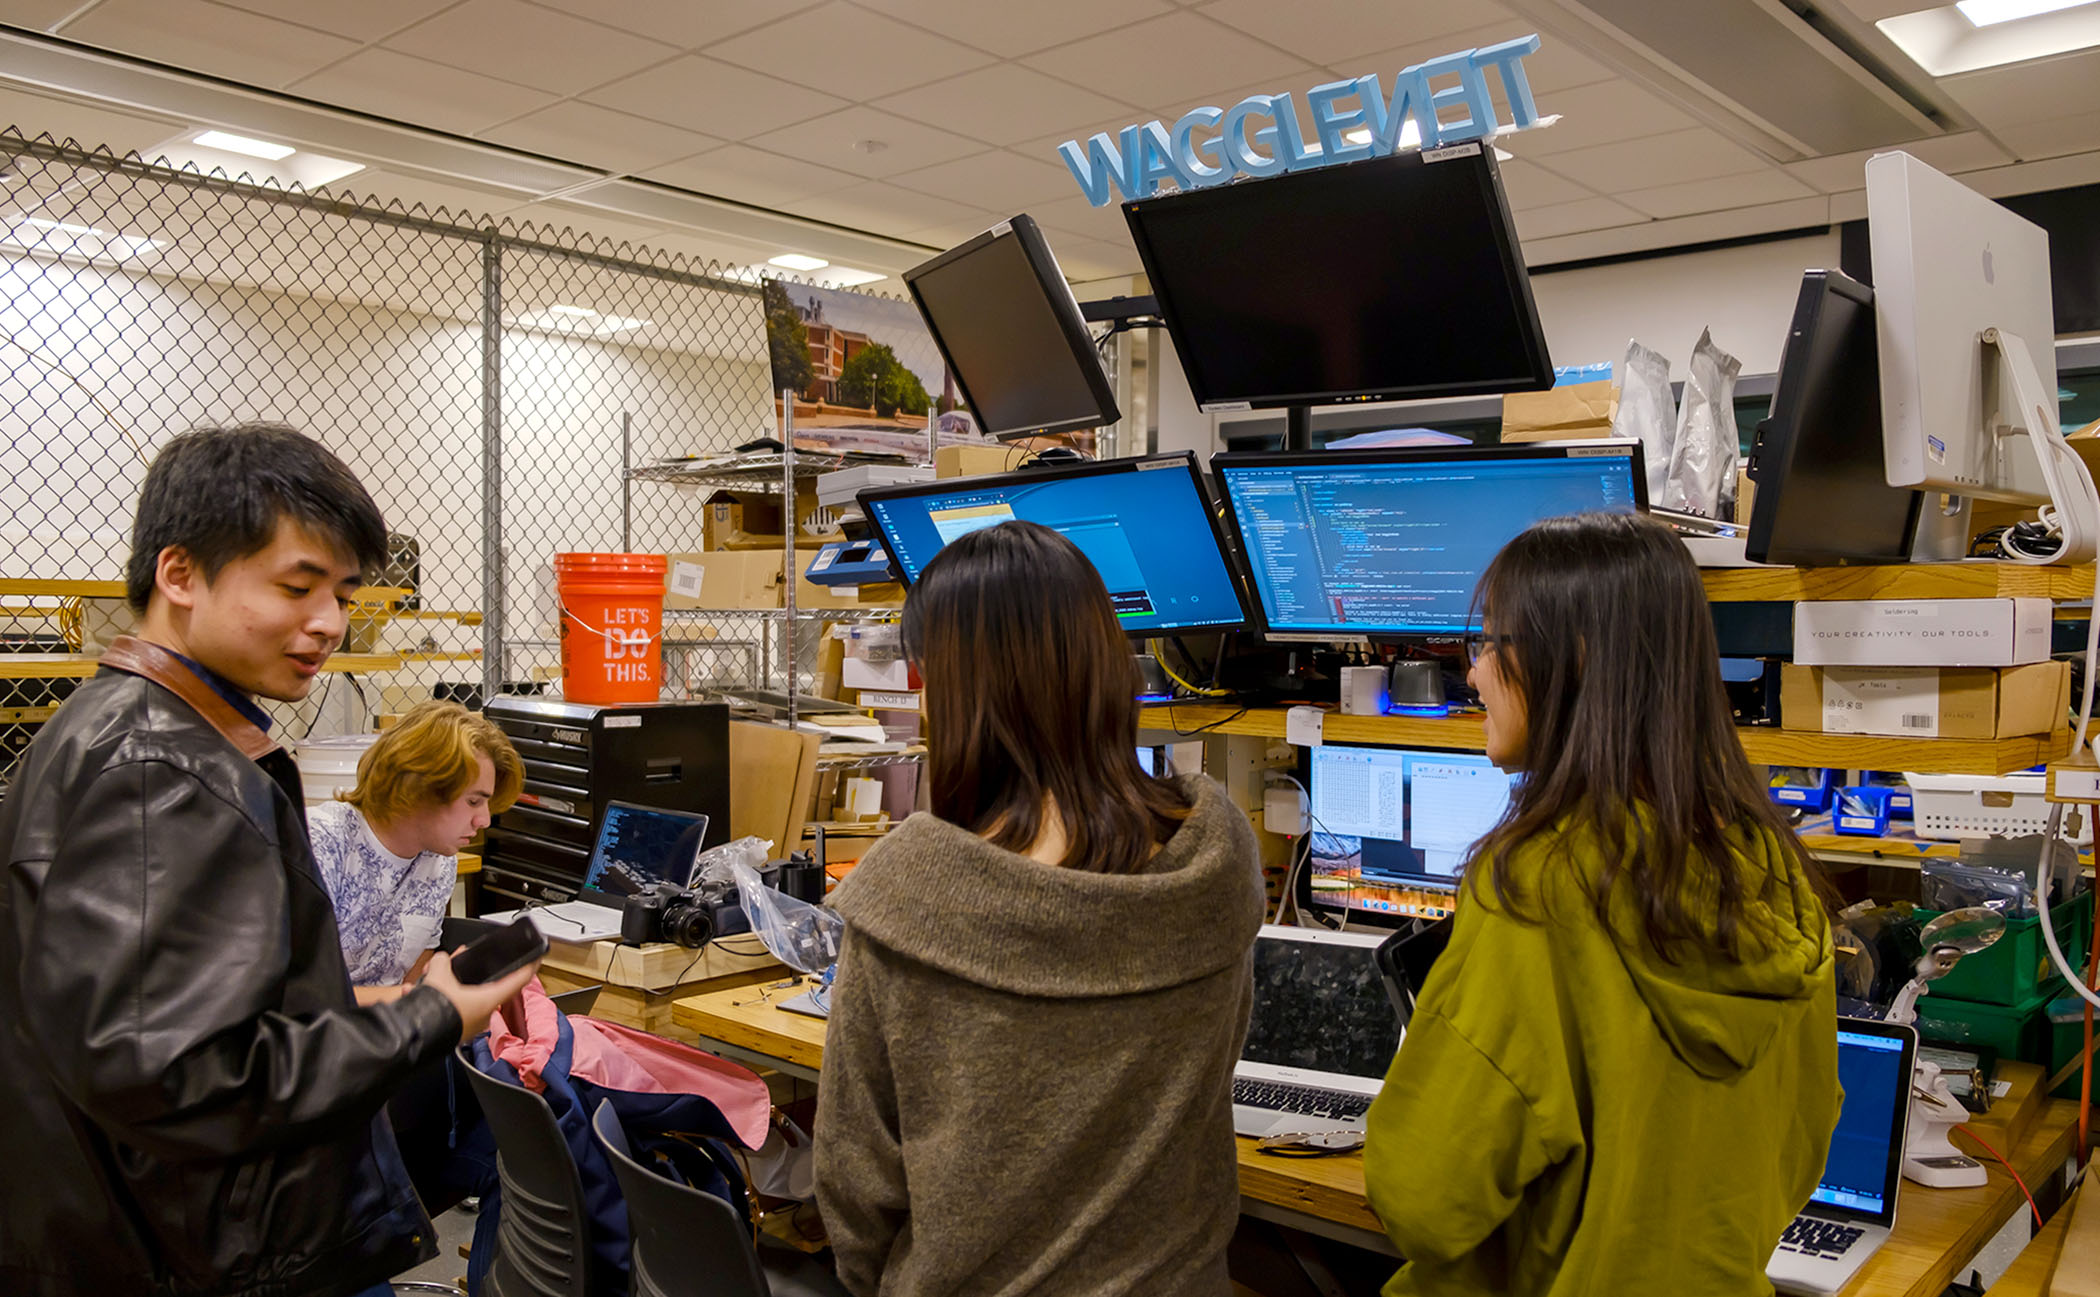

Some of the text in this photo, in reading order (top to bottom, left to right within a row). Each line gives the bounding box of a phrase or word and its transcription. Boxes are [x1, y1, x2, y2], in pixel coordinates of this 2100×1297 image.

[604, 607, 649, 624] LET'S
[1884, 608, 1919, 616] Soldering
[1426, 636, 1465, 645] SCEPT
[1921, 630, 1945, 638] OUR
[604, 627, 649, 659] DO
[603, 663, 651, 682] THIS.
